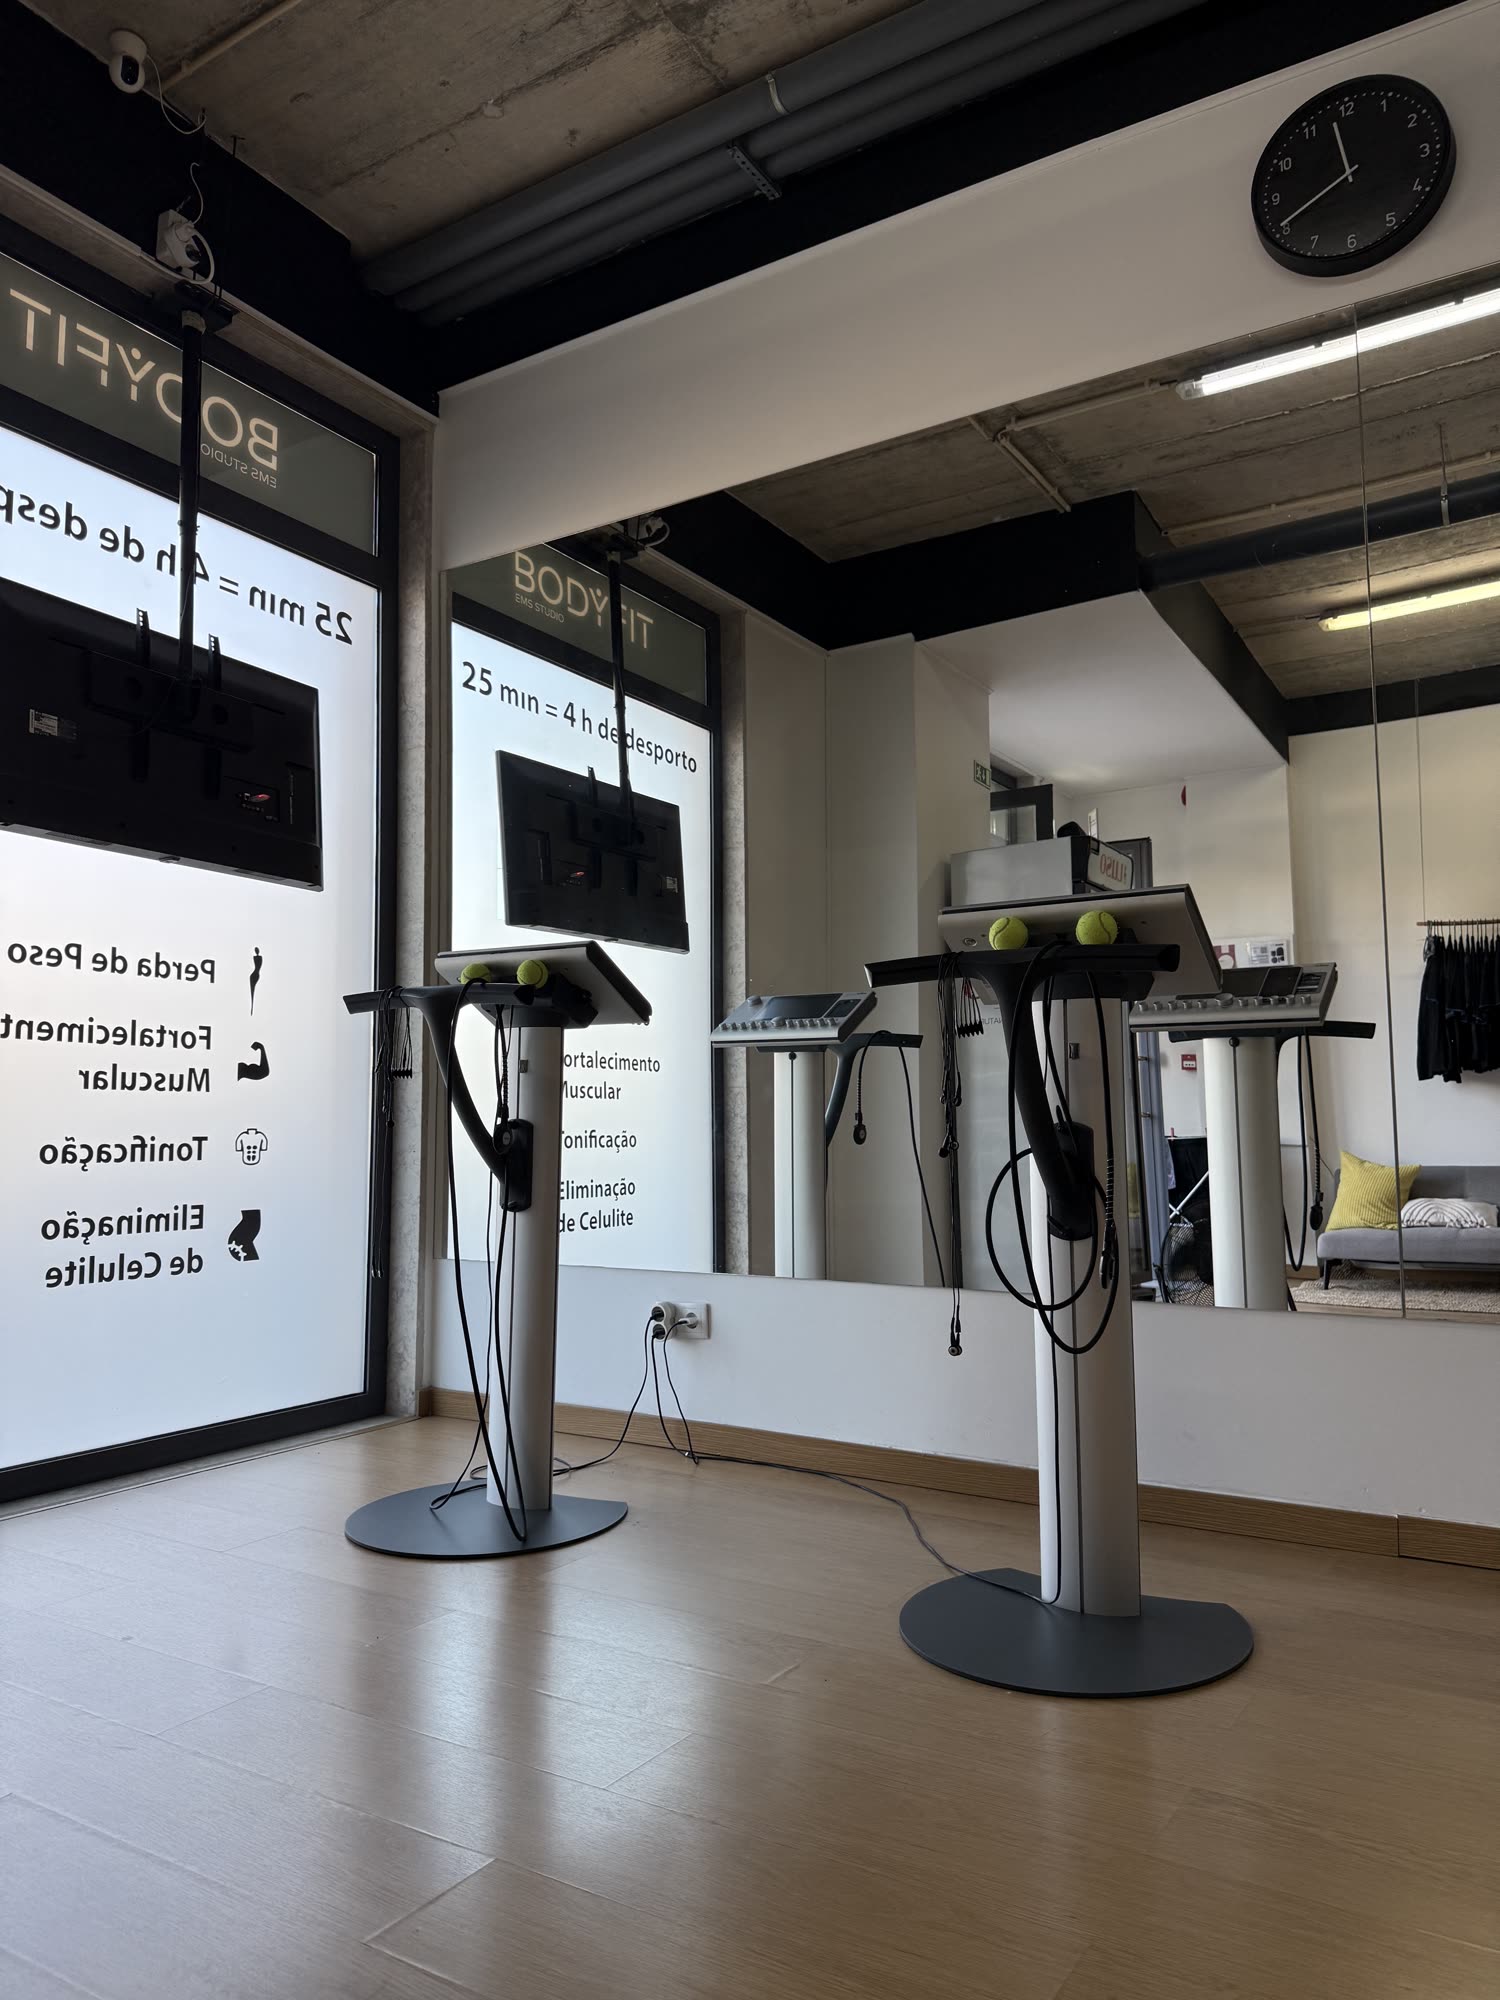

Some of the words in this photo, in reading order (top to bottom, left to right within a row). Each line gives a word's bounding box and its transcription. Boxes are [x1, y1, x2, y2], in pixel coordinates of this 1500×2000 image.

[1338, 101, 1355, 117] 12
[1380, 99, 1387, 113] 1
[1407, 113, 1418, 128] 2
[1303, 125, 1317, 139] 11
[1419, 143, 1430, 158] 3
[1278, 157, 1292, 172] 10
[1412, 178, 1422, 192] 4
[1271, 193, 1280, 206] 9
[1385, 212, 1396, 227] 5
[1282, 223, 1291, 236] 8
[1310, 235, 1319, 249] 7
[1347, 234, 1357, 249] 6
[514, 593, 534, 609] EMS
[534, 602, 565, 623] STUDIO
[461, 661, 493, 696] 25
[500, 683, 539, 715] min
[545, 703, 558, 718] =
[563, 701, 576, 728] 4
[582, 708, 592, 735] h
[598, 718, 619, 744] de
[625, 728, 698, 773] desporto
[563, 1050, 661, 1073] ortalecimento
[562, 1129, 637, 1153] onificação
[579, 1208, 634, 1231] Celulite
